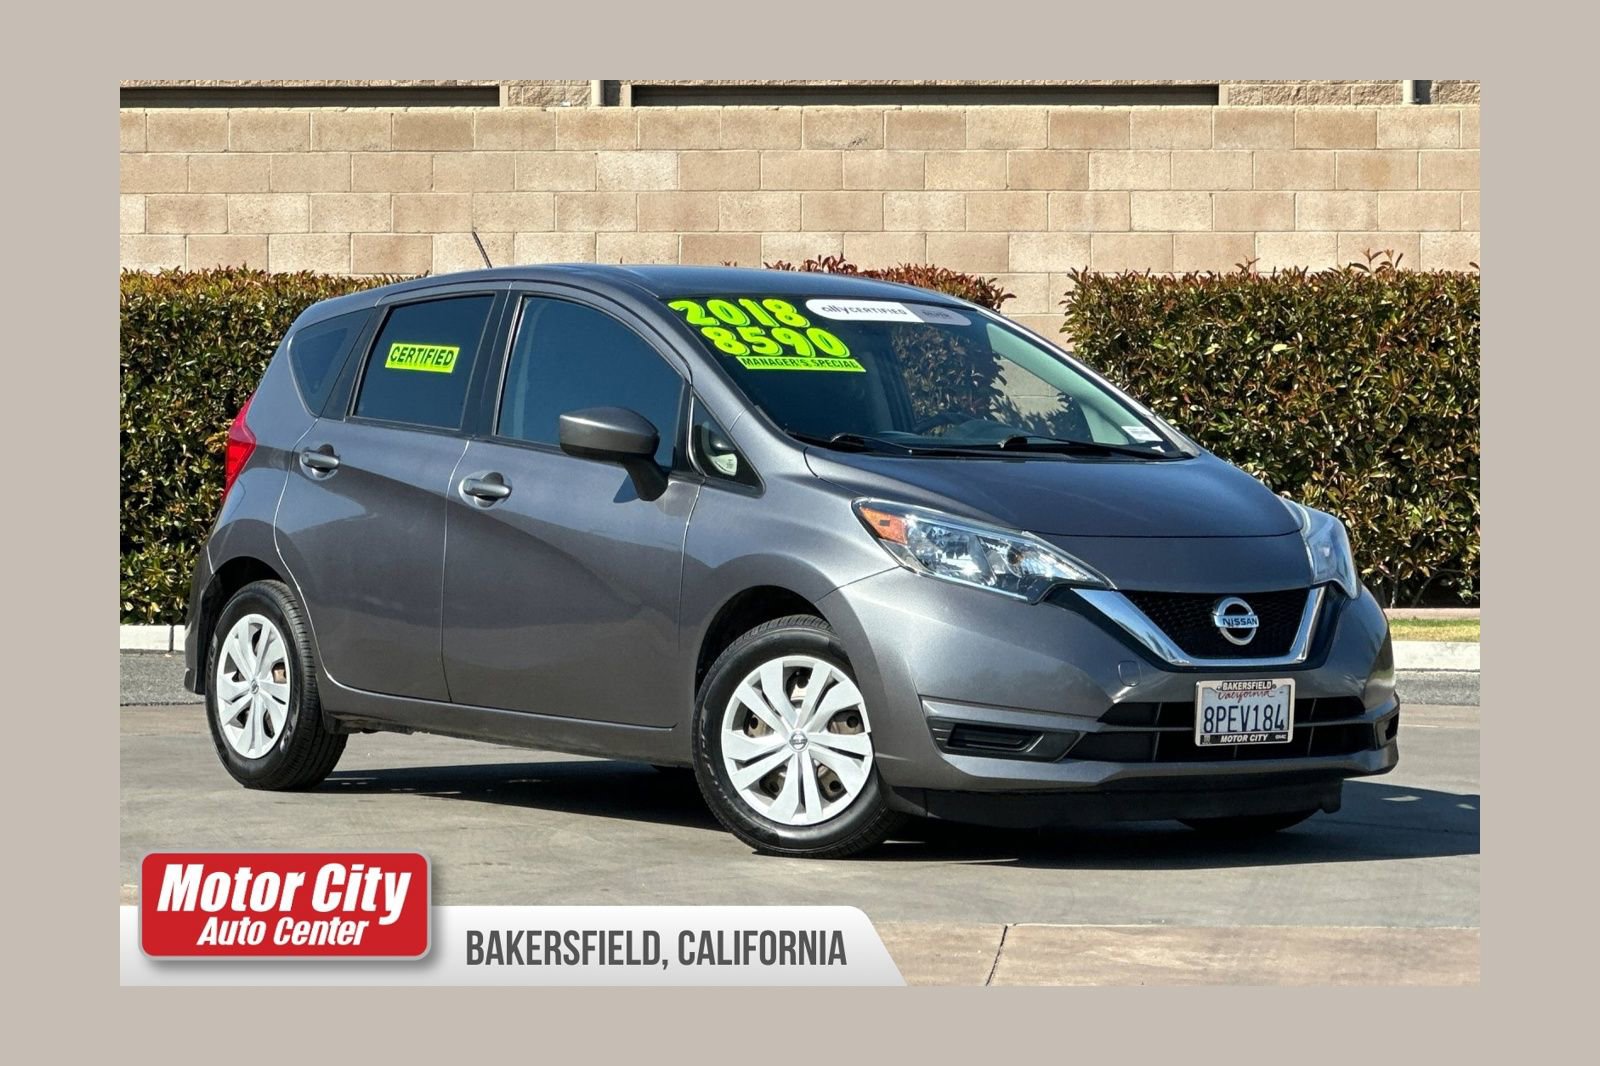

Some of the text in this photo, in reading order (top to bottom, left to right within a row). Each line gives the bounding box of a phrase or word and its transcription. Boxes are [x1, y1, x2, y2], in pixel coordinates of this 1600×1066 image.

[668, 298, 811, 327] 2018
[701, 326, 850, 357] 8590
[390, 346, 454, 365] CERTIFIED
[742, 357, 858, 369] MANAGER'S SPECIAL
[1222, 618, 1258, 626] NISSAN
[1222, 681, 1272, 690] BAKERSFIELD
[1203, 704, 1285, 734] 8PEV184
[1220, 735, 1248, 743] MOTOR
[1249, 733, 1268, 741] CITY
